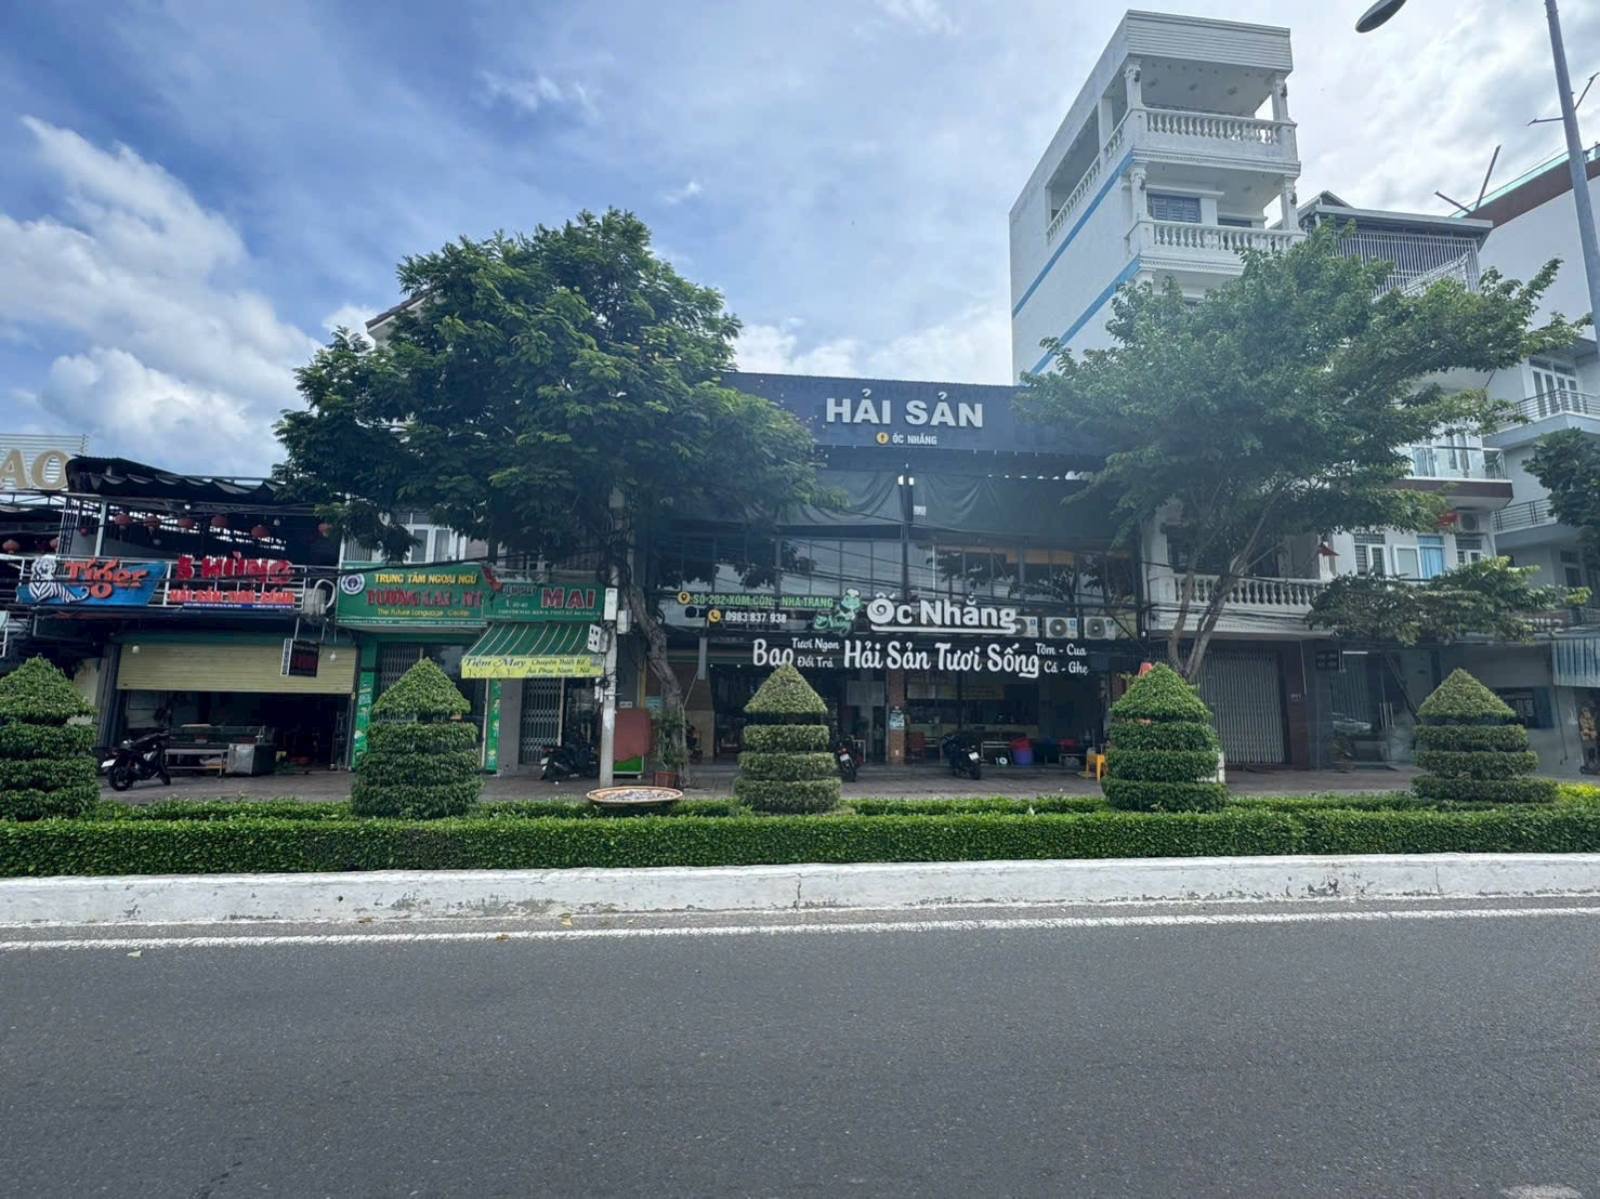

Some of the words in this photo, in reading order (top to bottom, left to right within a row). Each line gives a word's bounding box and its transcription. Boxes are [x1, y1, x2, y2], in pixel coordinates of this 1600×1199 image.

[826, 388, 891, 424] HẢI
[904, 391, 983, 427] SẢN
[64, 557, 148, 599] Tiger
[375, 573, 404, 584] TRUNG
[407, 571, 426, 584] TÂM
[428, 573, 456, 586] NGOẠI
[541, 587, 596, 609] MAI
[867, 592, 912, 625] Ốc
[753, 638, 794, 668] Bao
[791, 637, 812, 649] Tươi
[815, 638, 840, 652] Ngon
[1035, 642, 1056, 655] Tôm
[1066, 643, 1086, 656] Cua
[844, 640, 884, 668] Hải
[887, 641, 931, 669] Sản
[934, 642, 982, 671] Tươi
[987, 643, 1039, 678] Sống
[1044, 660, 1058, 673] Cá
[1068, 660, 1089, 676] Ghẹ
